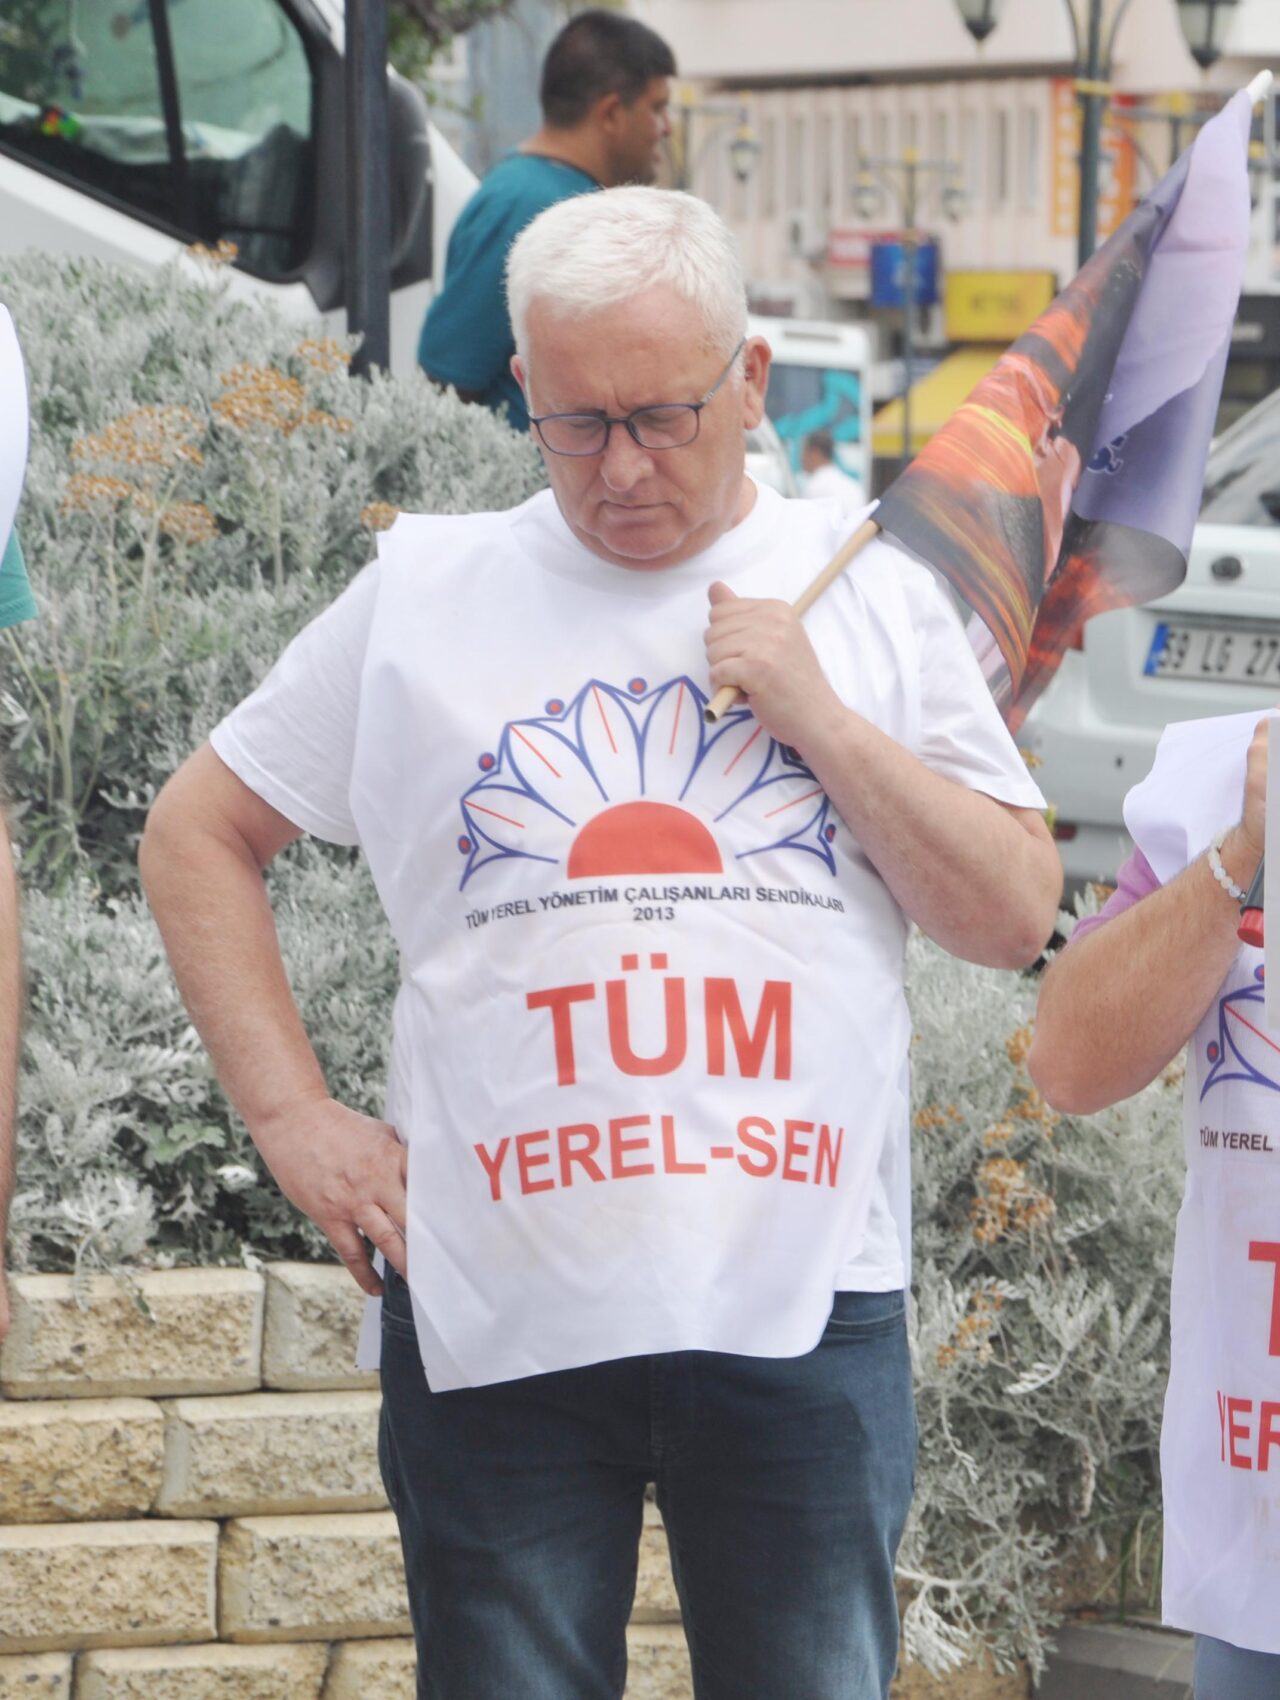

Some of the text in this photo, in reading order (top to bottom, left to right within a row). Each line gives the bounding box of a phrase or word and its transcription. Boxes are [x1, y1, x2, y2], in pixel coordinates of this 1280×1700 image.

[538, 886, 618, 911] YÖNETİM
[624, 886, 751, 903] ÇALIŞANLARI
[756, 886, 845, 913] SENDİKALARI
[633, 906, 675, 922] 2013
[526, 953, 792, 1087] TÜM
[1200, 1126, 1218, 1148] TÜM
[1222, 1132, 1273, 1152] YEREL
[473, 1114, 844, 1202] YEREL-SEN
